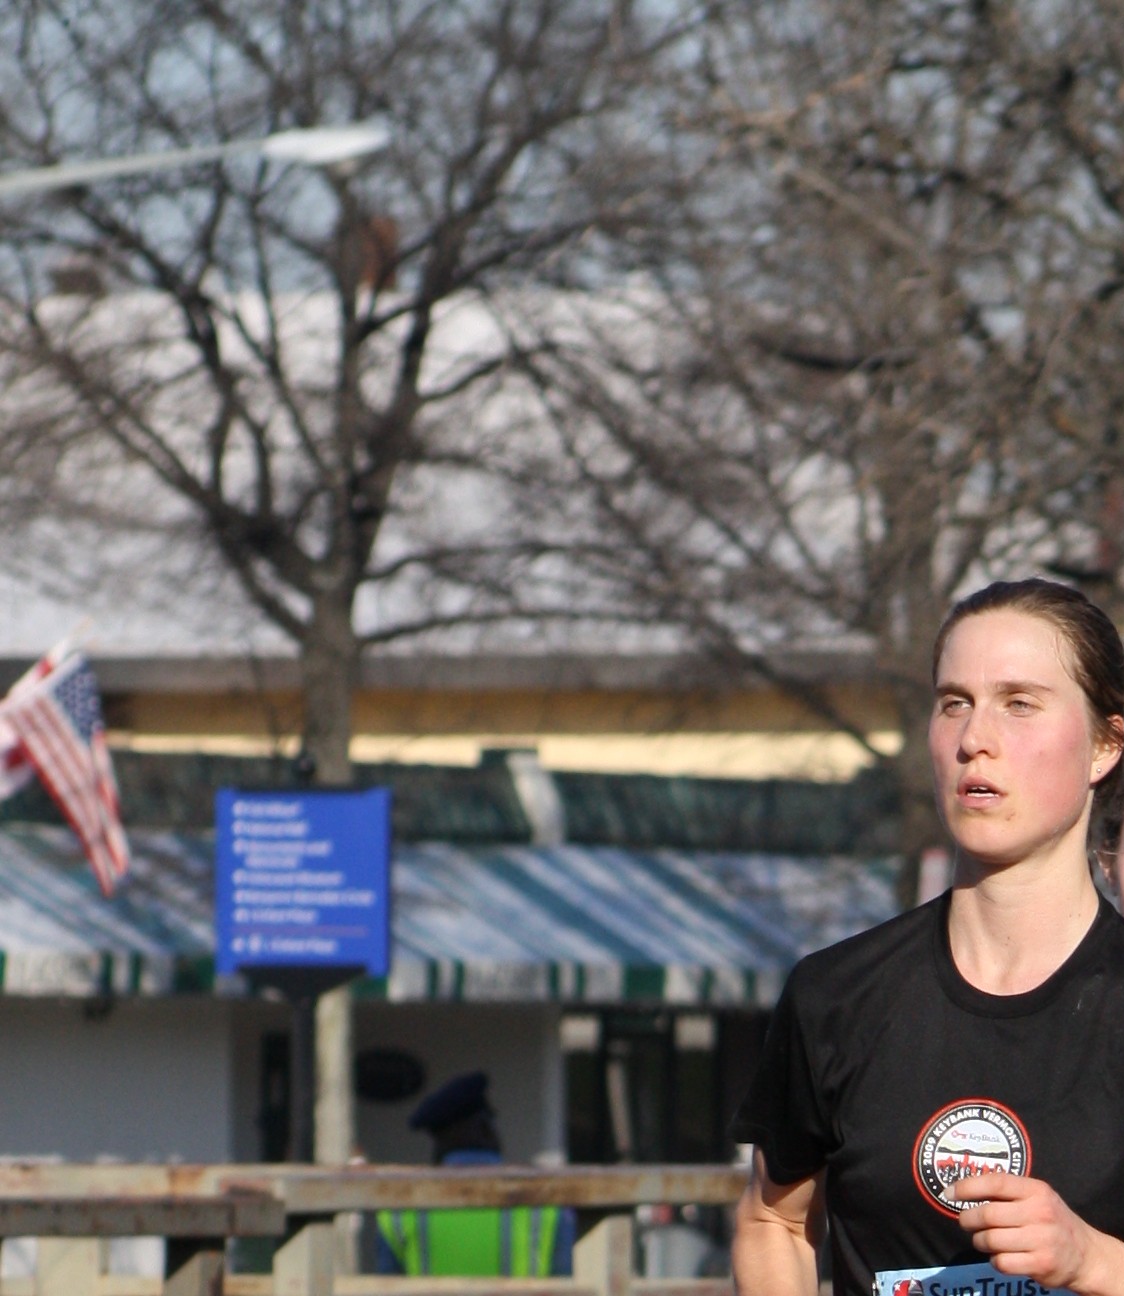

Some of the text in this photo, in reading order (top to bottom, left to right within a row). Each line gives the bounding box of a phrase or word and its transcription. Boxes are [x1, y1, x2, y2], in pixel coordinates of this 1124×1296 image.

[923, 1108, 1022, 1176] 2009 KEYBANK VERMONT CITY
